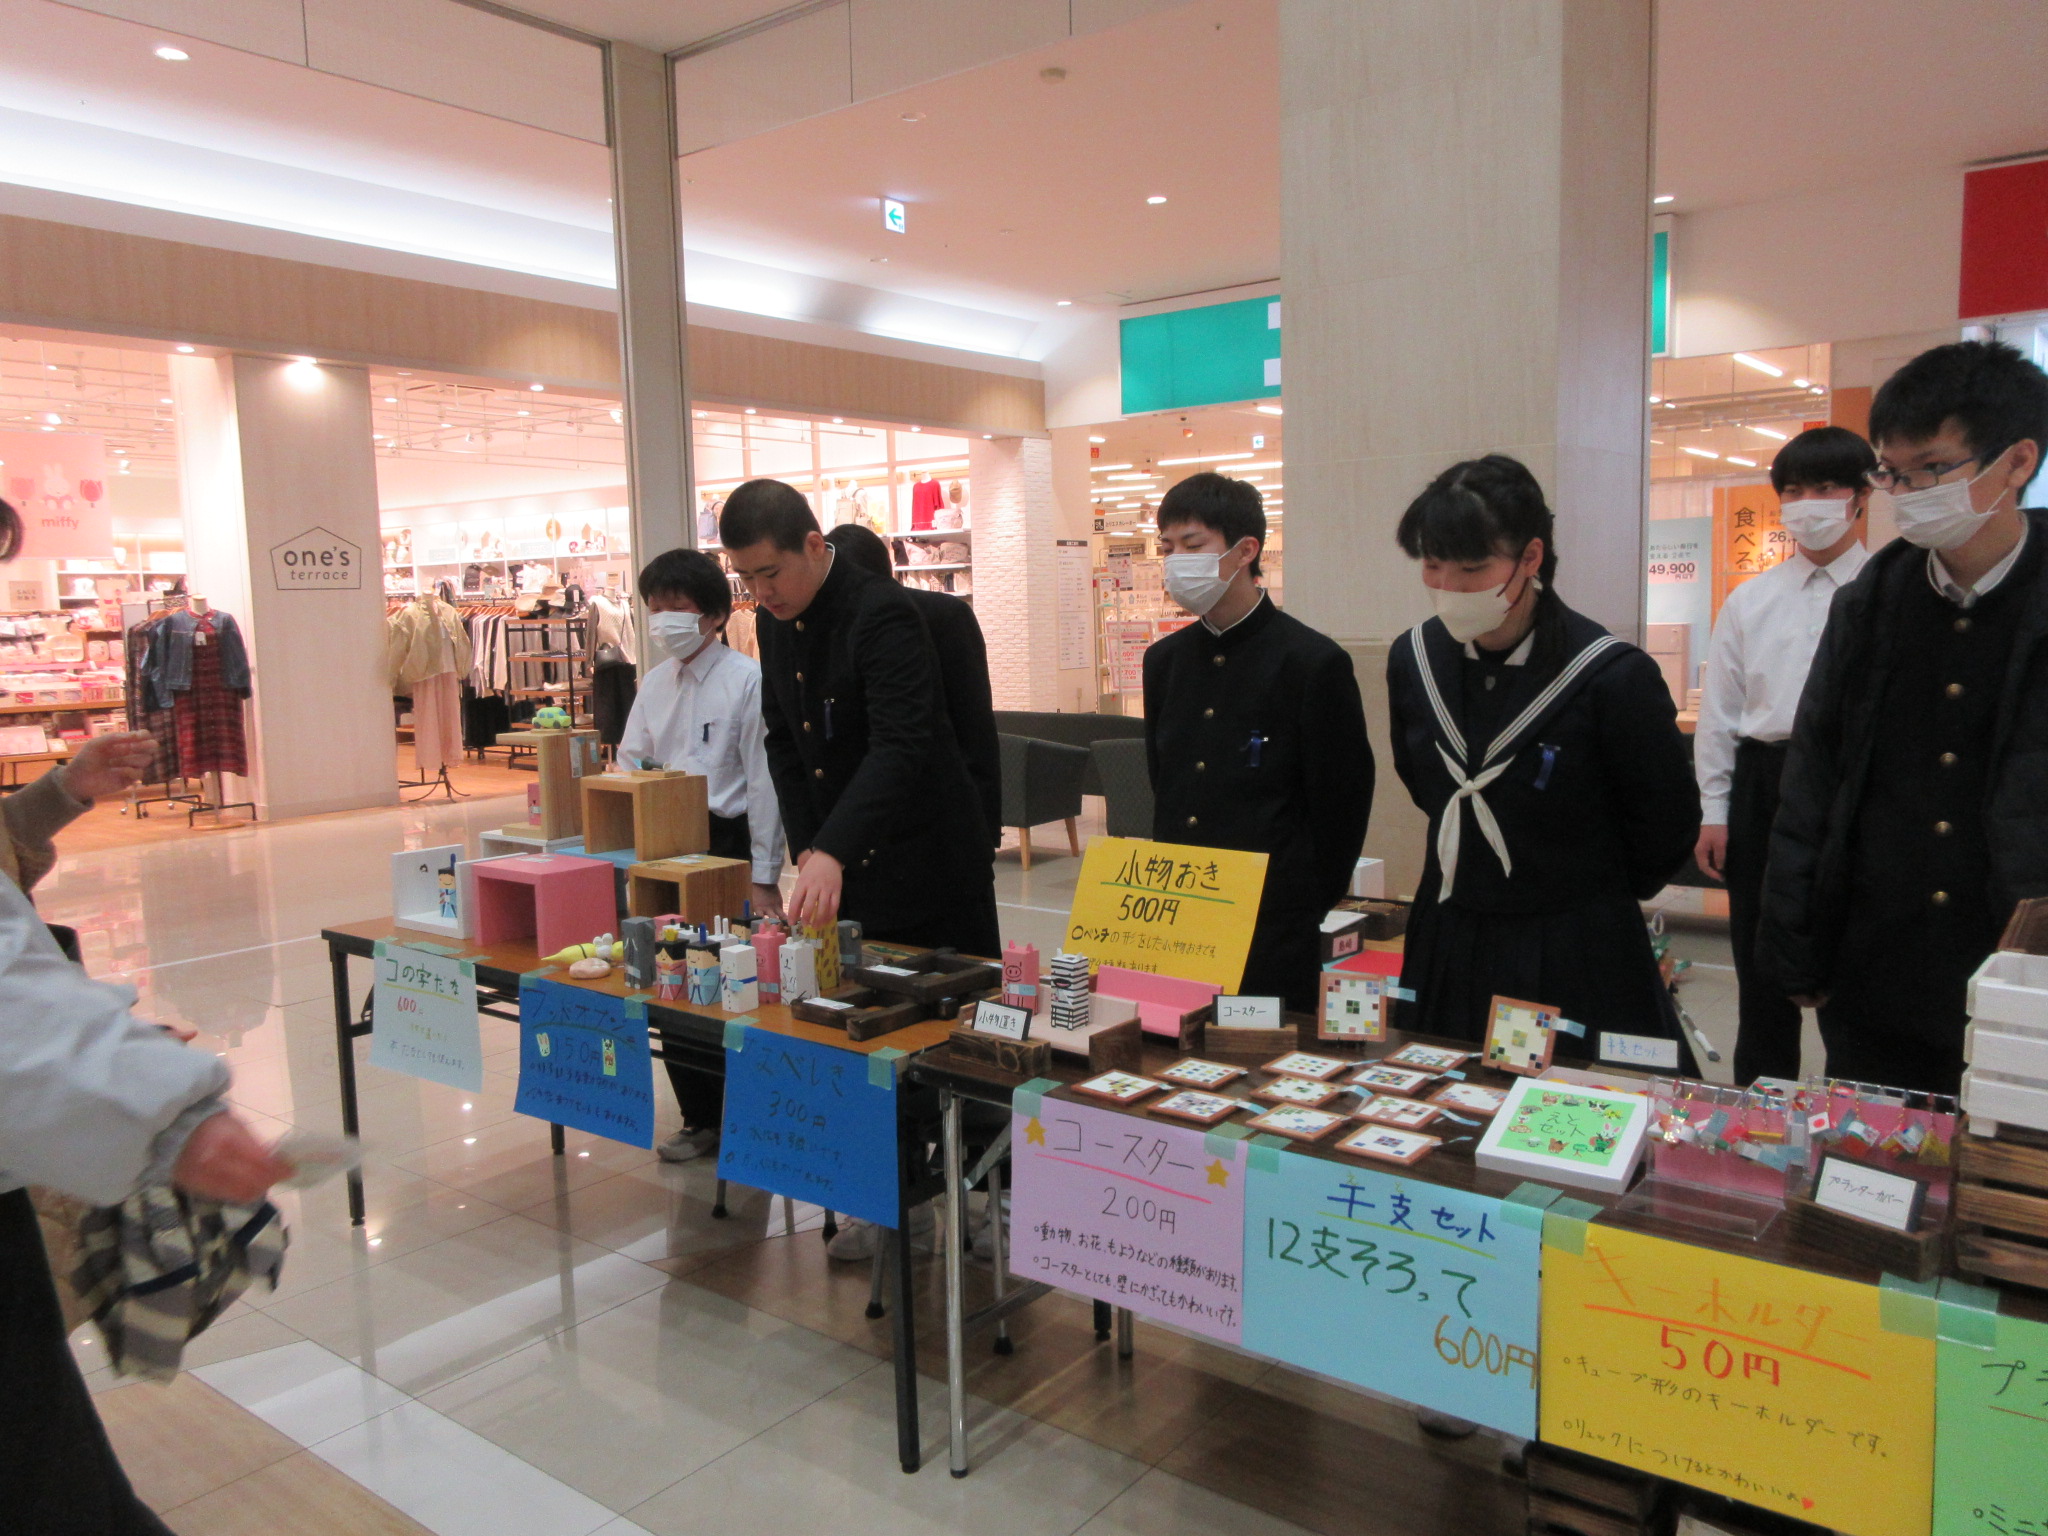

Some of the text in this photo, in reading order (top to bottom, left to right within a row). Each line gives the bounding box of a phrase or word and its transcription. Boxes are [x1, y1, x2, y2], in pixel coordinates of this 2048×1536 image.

[41, 515, 80, 530] miffy
[283, 545, 350, 567] one's
[290, 569, 349, 581] terrace
[1115, 849, 1221, 891] 小物おき
[1118, 894, 1181, 925] 500円
[385, 958, 460, 996] コの字だな
[978, 1009, 1017, 1032] 小物置き
[1223, 1005, 1267, 1017] コースター
[1539, 1123, 1586, 1138] セット
[1546, 1111, 1581, 1126] えと
[1053, 1118, 1195, 1176] コースター
[1101, 1186, 1176, 1235] 200円
[1326, 1182, 1496, 1243] 干支セット
[1267, 1217, 1478, 1319] 12支そろって
[1583, 1245, 1872, 1352] キーホルダー
[1433, 1314, 1537, 1390] 600円
[1660, 1324, 1782, 1388] 50円
